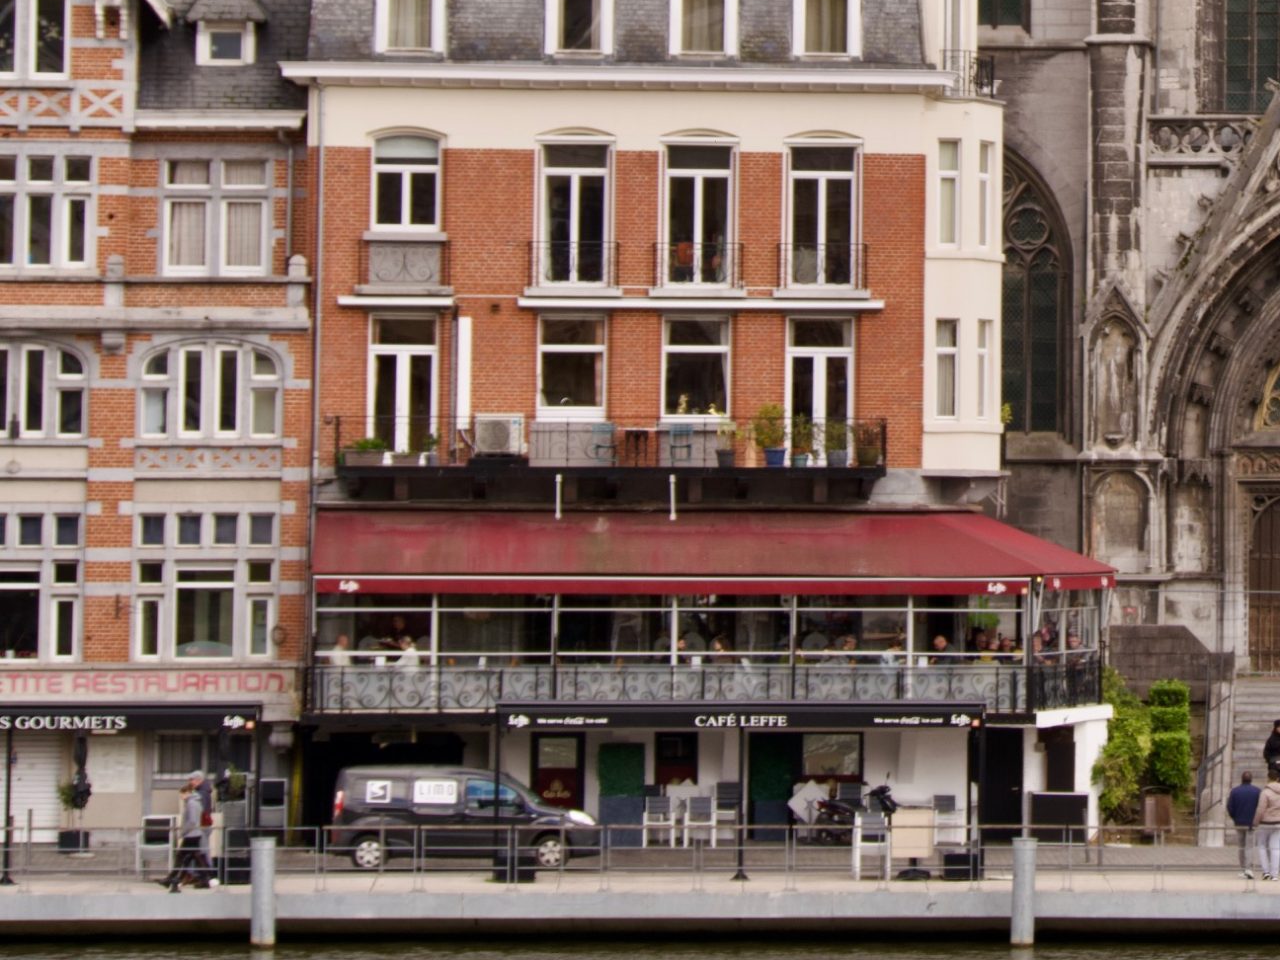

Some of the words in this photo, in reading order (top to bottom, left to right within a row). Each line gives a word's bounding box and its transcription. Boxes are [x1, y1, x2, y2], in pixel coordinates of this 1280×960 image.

[0, 672, 62, 693] TITE
[14, 715, 127, 730] GOURMETS
[694, 713, 737, 727] CAFÉ
[739, 715, 788, 727] LEFFE
